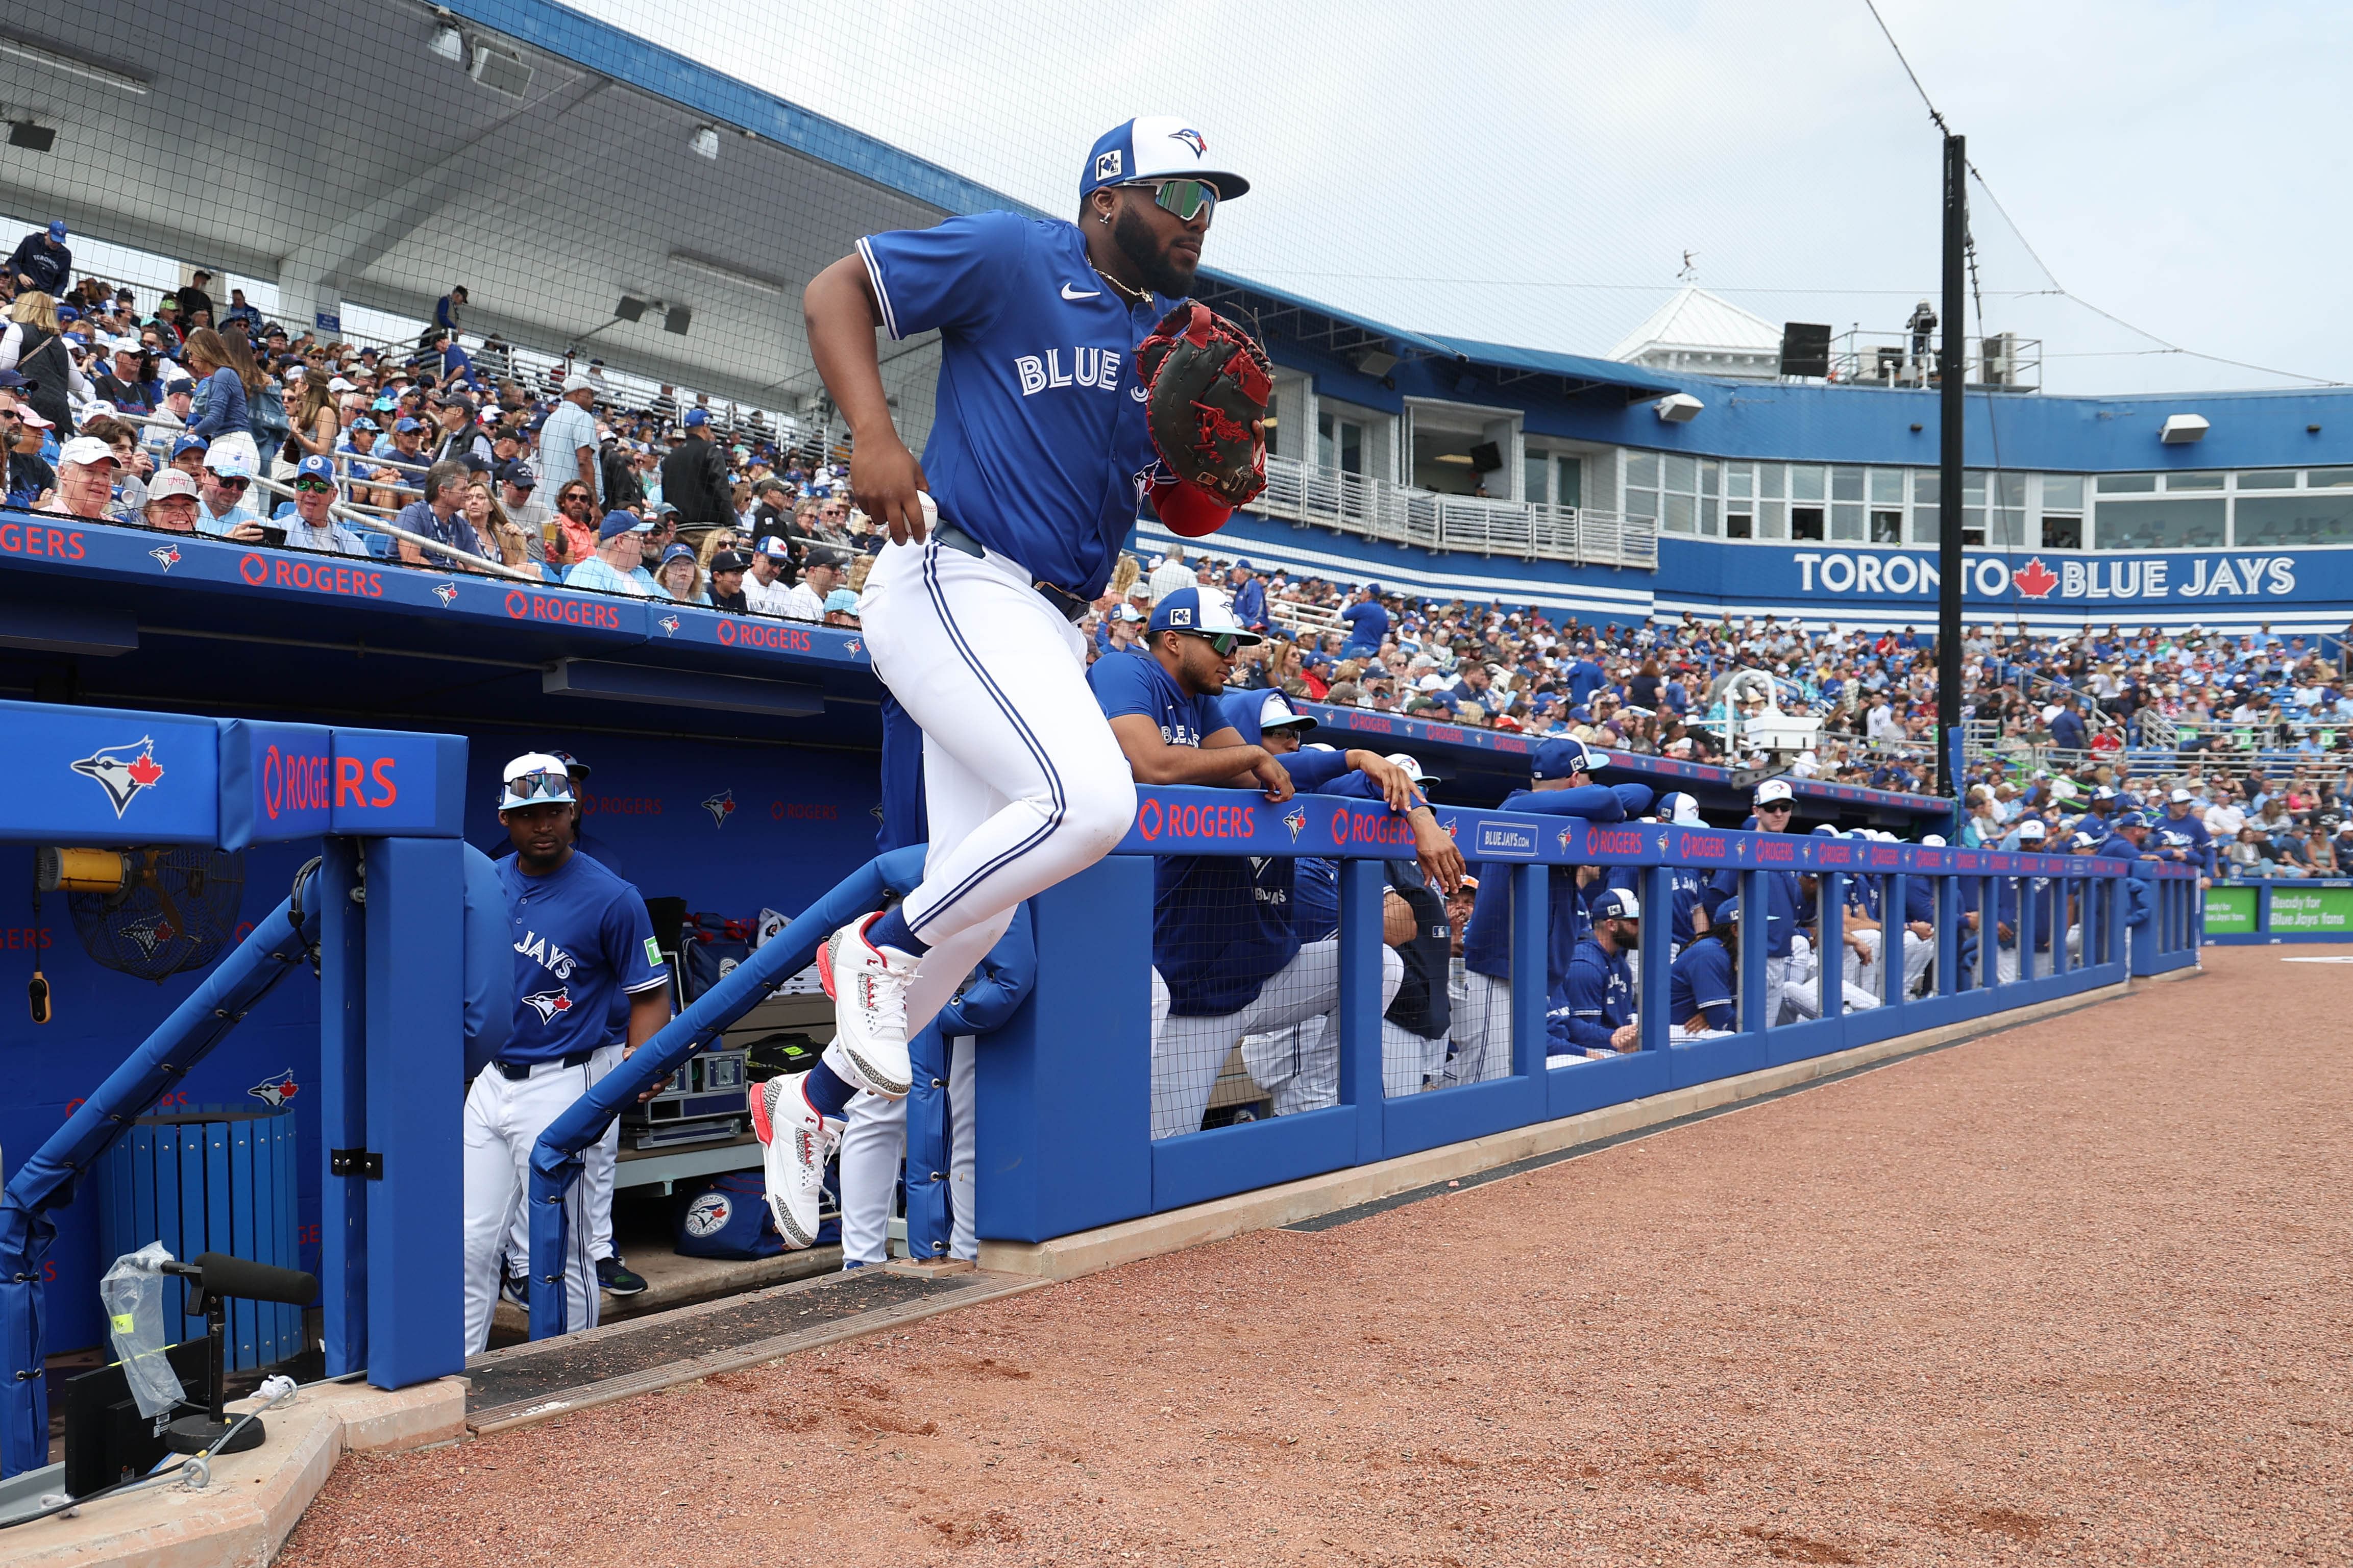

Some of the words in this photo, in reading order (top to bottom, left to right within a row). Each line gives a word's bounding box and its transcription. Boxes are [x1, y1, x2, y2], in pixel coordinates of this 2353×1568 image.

[1014, 346, 1121, 396] BLUE
[276, 560, 383, 598] ROGERS
[1794, 553, 2009, 593] TORONTO
[2061, 560, 2169, 599] BLUE
[2178, 557, 2296, 596] JAYS
[533, 596, 619, 629] ROGERS
[740, 624, 811, 652] ROGERS
[1359, 716, 1391, 733] ROGERS
[1435, 728, 1464, 743] ROGERS
[287, 755, 397, 810] ROGERS
[601, 797, 663, 815] ROGERS
[788, 803, 838, 820] ROGERS
[1168, 804, 1255, 838] ROGERS
[1484, 830, 1530, 848] BLUEJAYS.COM
[1600, 830, 1643, 855] ROGERS
[1689, 836, 1726, 858] ROGERS
[1763, 842, 1794, 861] ROGERS
[1826, 845, 1851, 863] ROGERS
[0, 928, 52, 949] ERS
[513, 930, 576, 979] JAYS
[692, 1196, 722, 1210] TORONTO
[687, 1219, 701, 1234] BLUE
[703, 1219, 723, 1233] JAYS
